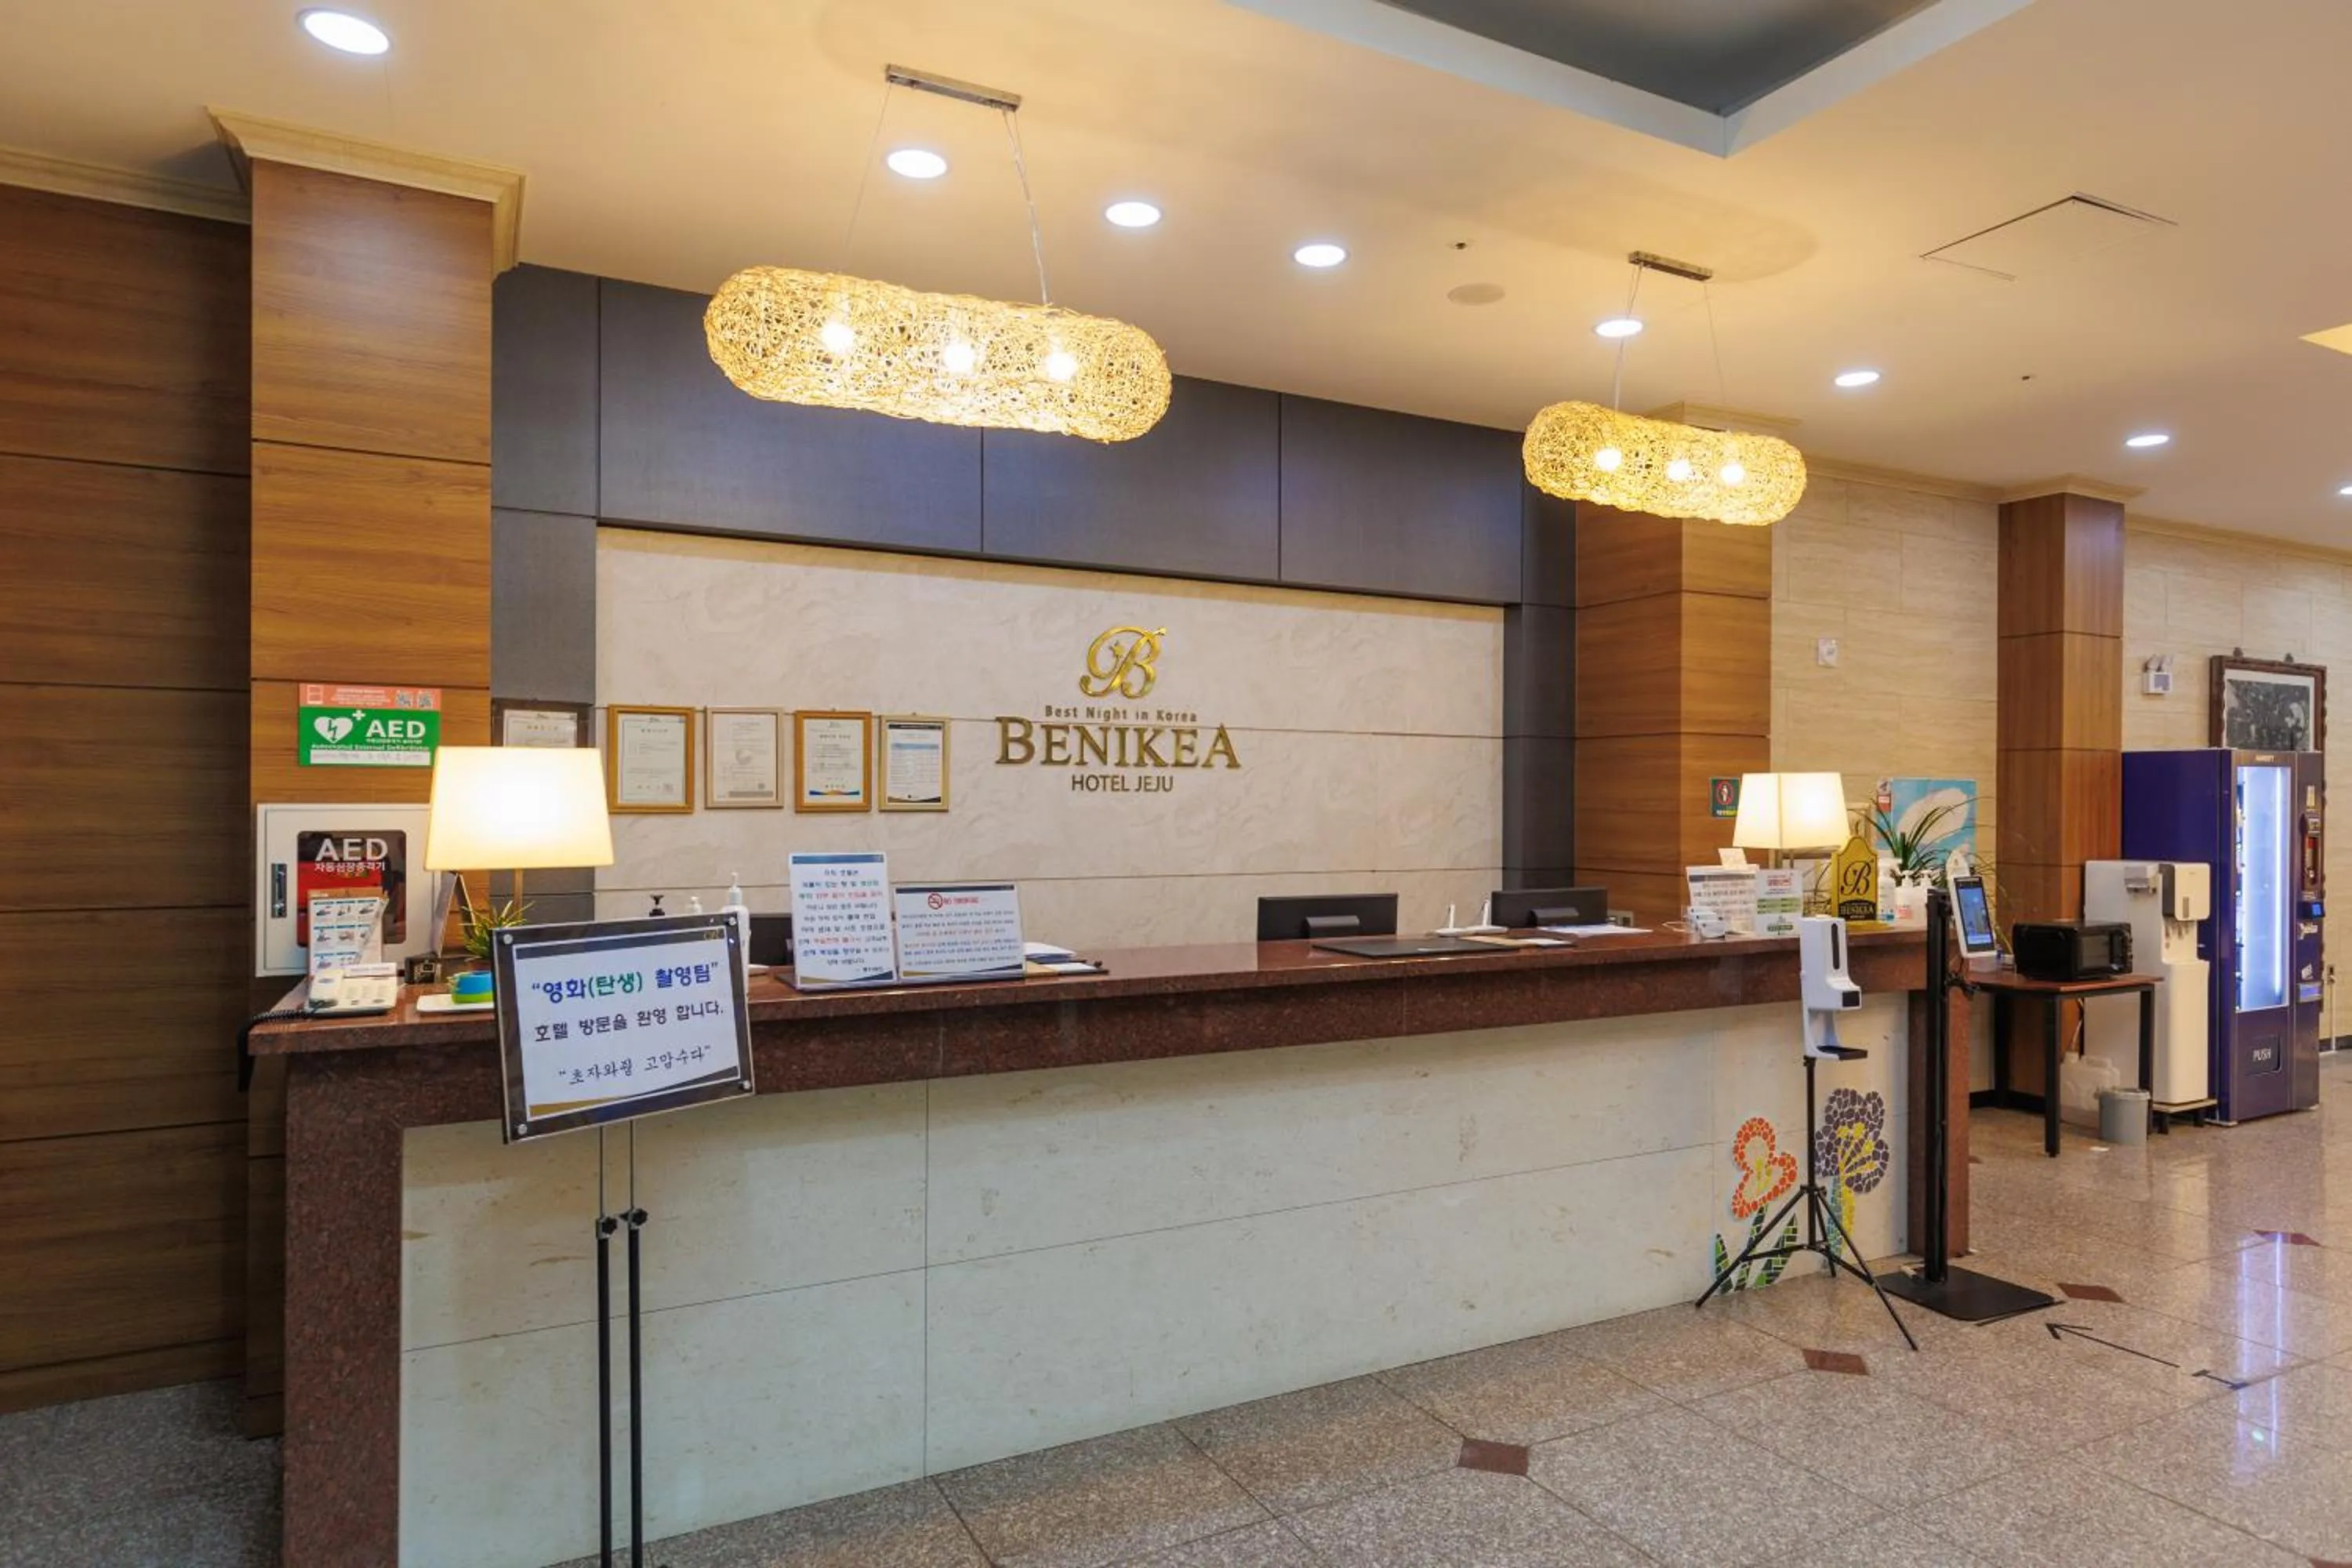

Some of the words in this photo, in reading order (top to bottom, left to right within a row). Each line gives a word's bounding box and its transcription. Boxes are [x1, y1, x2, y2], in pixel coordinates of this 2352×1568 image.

[1044, 705, 1079, 718] Best
[1086, 707, 1128, 722] Night
[1134, 710, 1149, 720] in
[1156, 710, 1198, 722] Korea
[365, 720, 426, 739] AED
[994, 716, 1242, 769] BENIKEA
[1072, 774, 1130, 792] HOTEL
[1134, 775, 1174, 793] JEJU
[314, 838, 389, 862] AED
[314, 862, 386, 873] 자동심장충격기
[534, 1022, 568, 1042] 호텔
[579, 1013, 628, 1036] 방문을
[637, 1007, 667, 1027] 환영
[677, 1000, 724, 1021] 합니다.
[2252, 1048, 2272, 1062] PUSH
